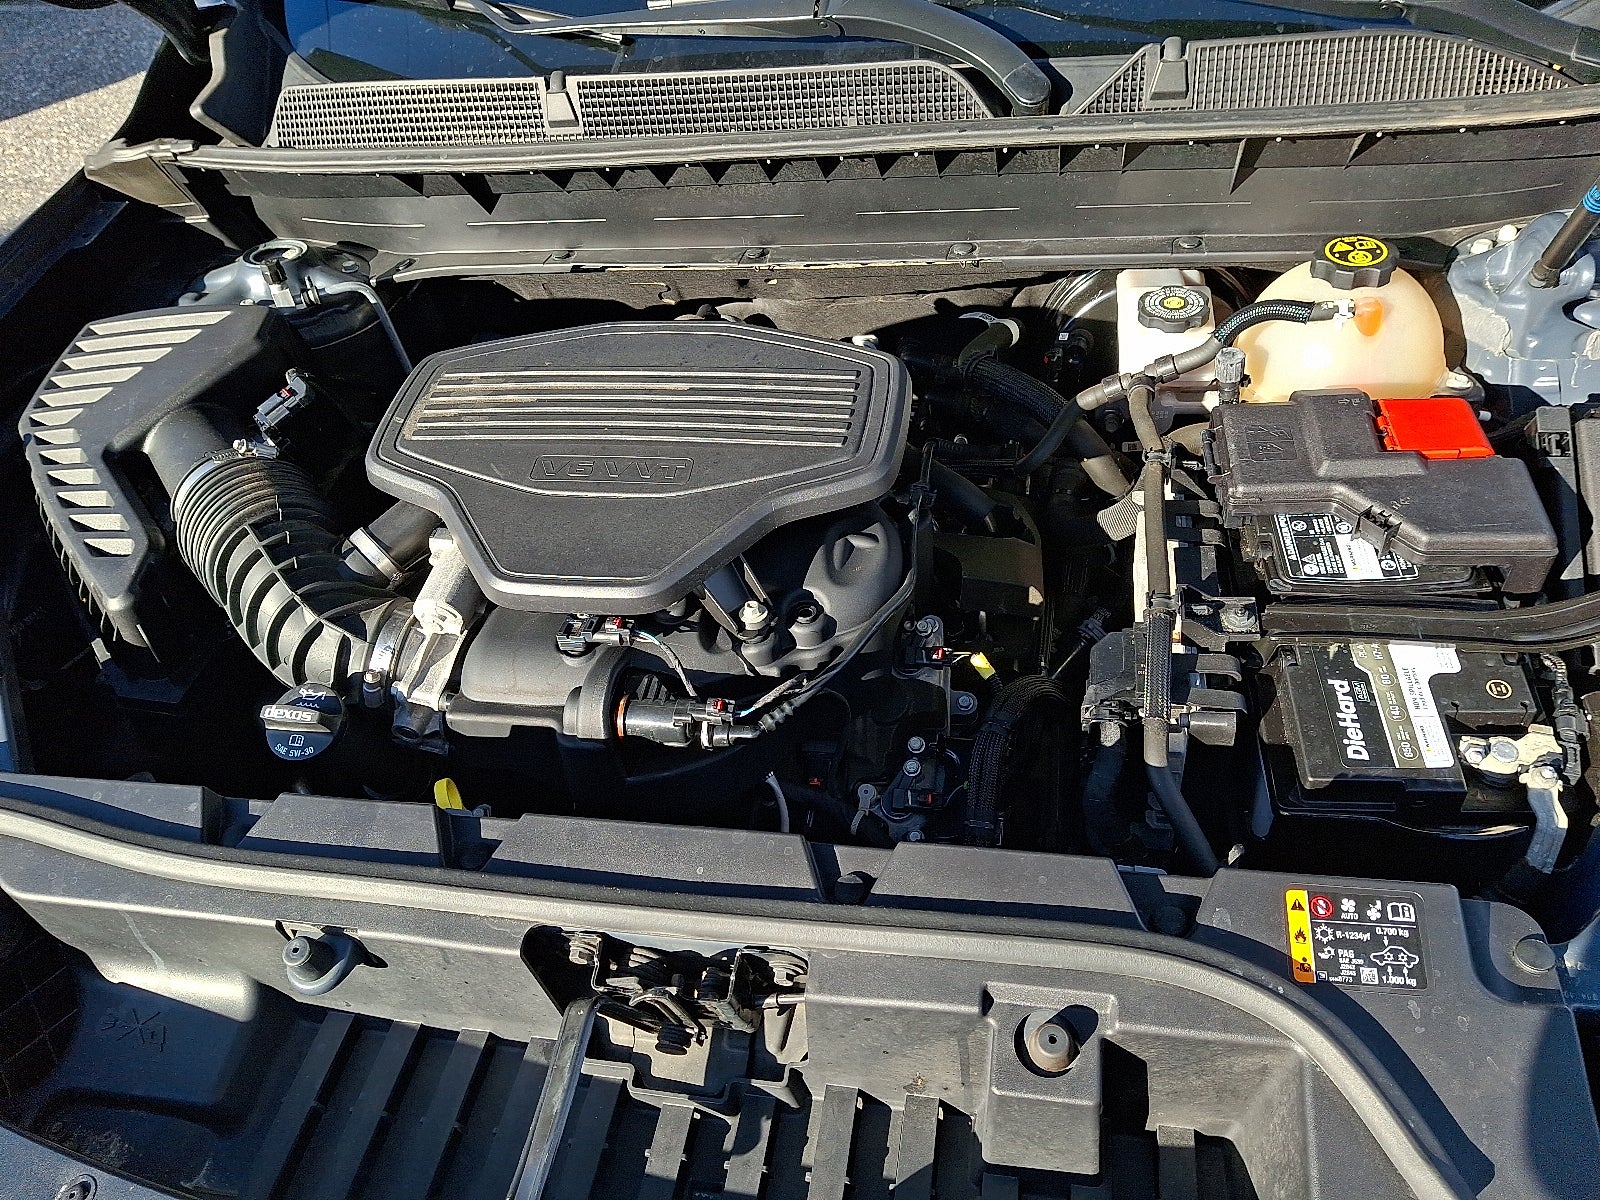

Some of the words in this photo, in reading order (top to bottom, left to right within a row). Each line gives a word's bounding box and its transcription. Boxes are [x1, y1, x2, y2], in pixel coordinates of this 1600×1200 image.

[542, 460, 596, 477] V6
[604, 461, 687, 479] VVT
[1381, 674, 1392, 685] 80
[264, 705, 312, 721] dexos
[1390, 706, 1401, 719] 140
[1327, 679, 1370, 761] DieHard
[274, 743, 288, 755] SAE
[289, 746, 314, 757] 5W-30
[1341, 912, 1359, 920] AUTO
[1335, 930, 1371, 942] R-1234yf
[1375, 926, 1397, 936] 0.700
[1398, 928, 1410, 938] kg
[1337, 948, 1355, 959] PAG
[1382, 975, 1405, 985] 1.000
[1405, 975, 1417, 987] kg
